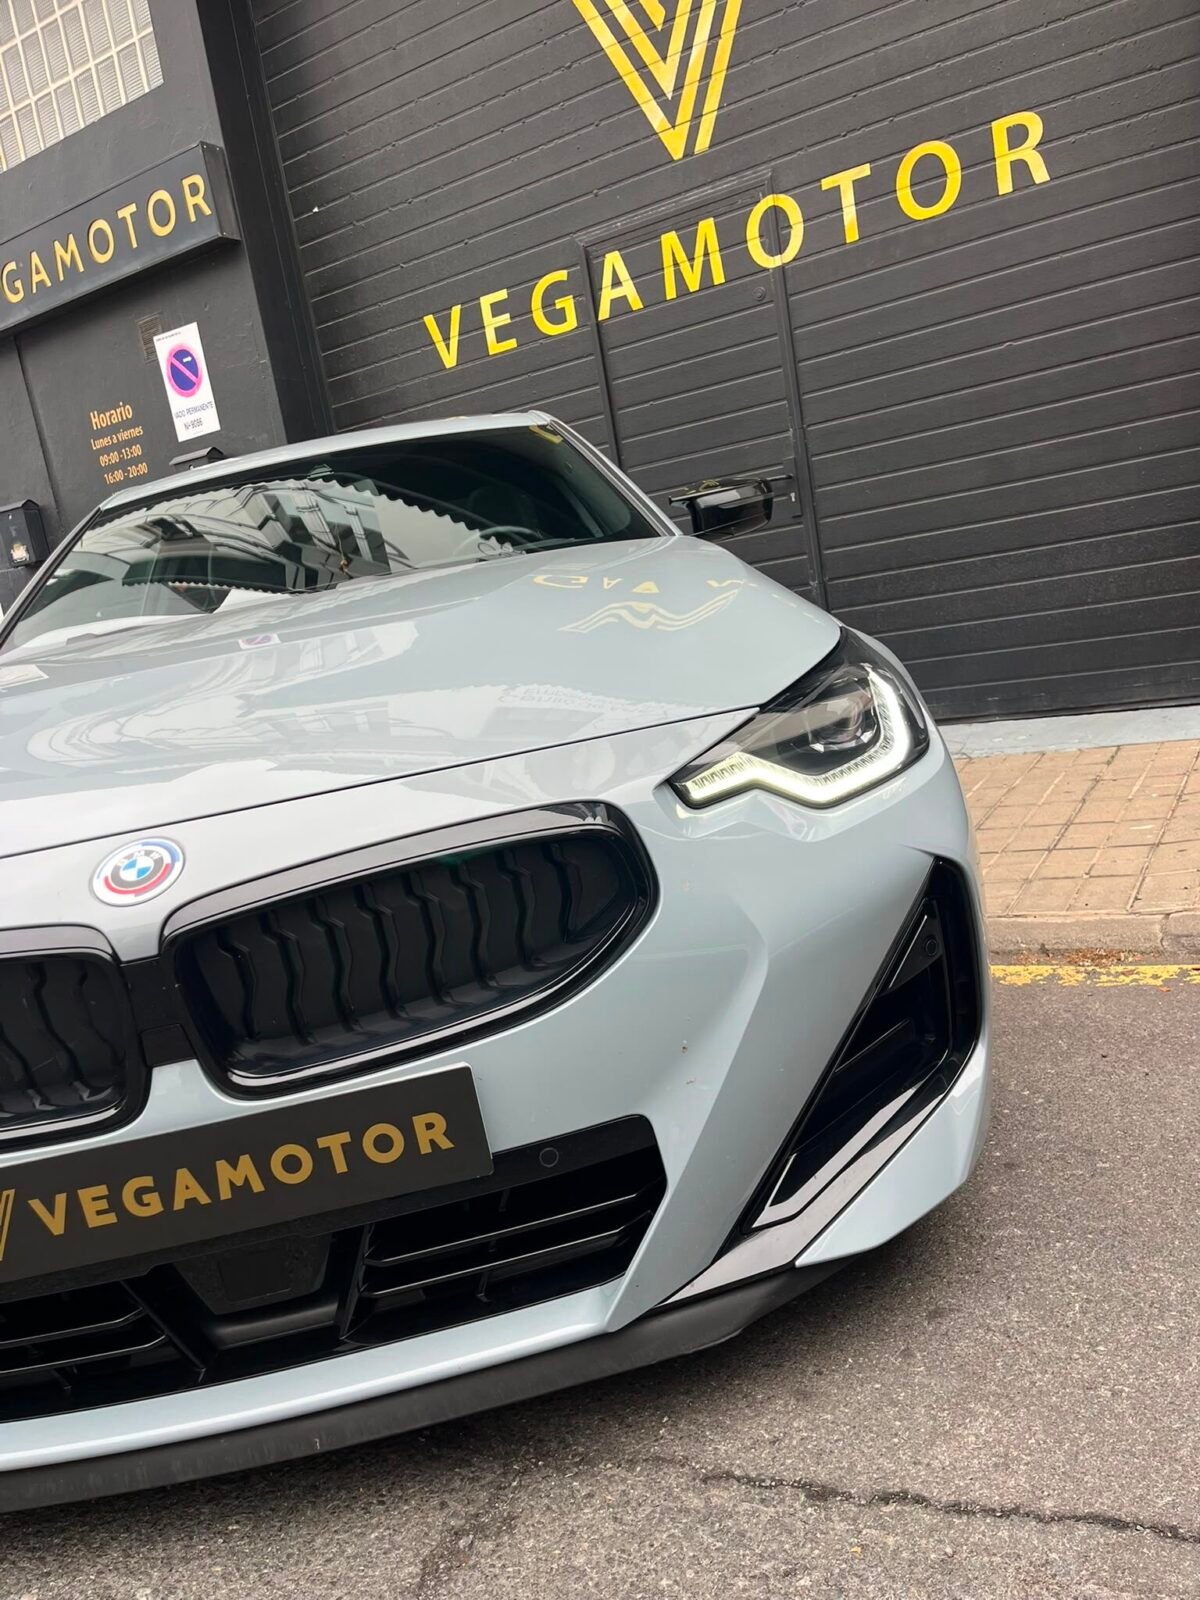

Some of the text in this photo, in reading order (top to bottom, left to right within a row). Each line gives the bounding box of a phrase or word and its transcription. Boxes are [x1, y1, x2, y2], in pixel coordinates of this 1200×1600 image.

[1, 174, 213, 303] GAMOTOR
[421, 112, 1049, 369] VEGAMOTOR
[90, 401, 133, 430] Horario
[91, 425, 144, 450] Lunes a viernes
[100, 451, 120, 467] 09:00
[104, 469, 124, 484] 16:00
[128, 462, 149, 478] 20:00
[28, 1112, 455, 1236] VEGAMOTOR
